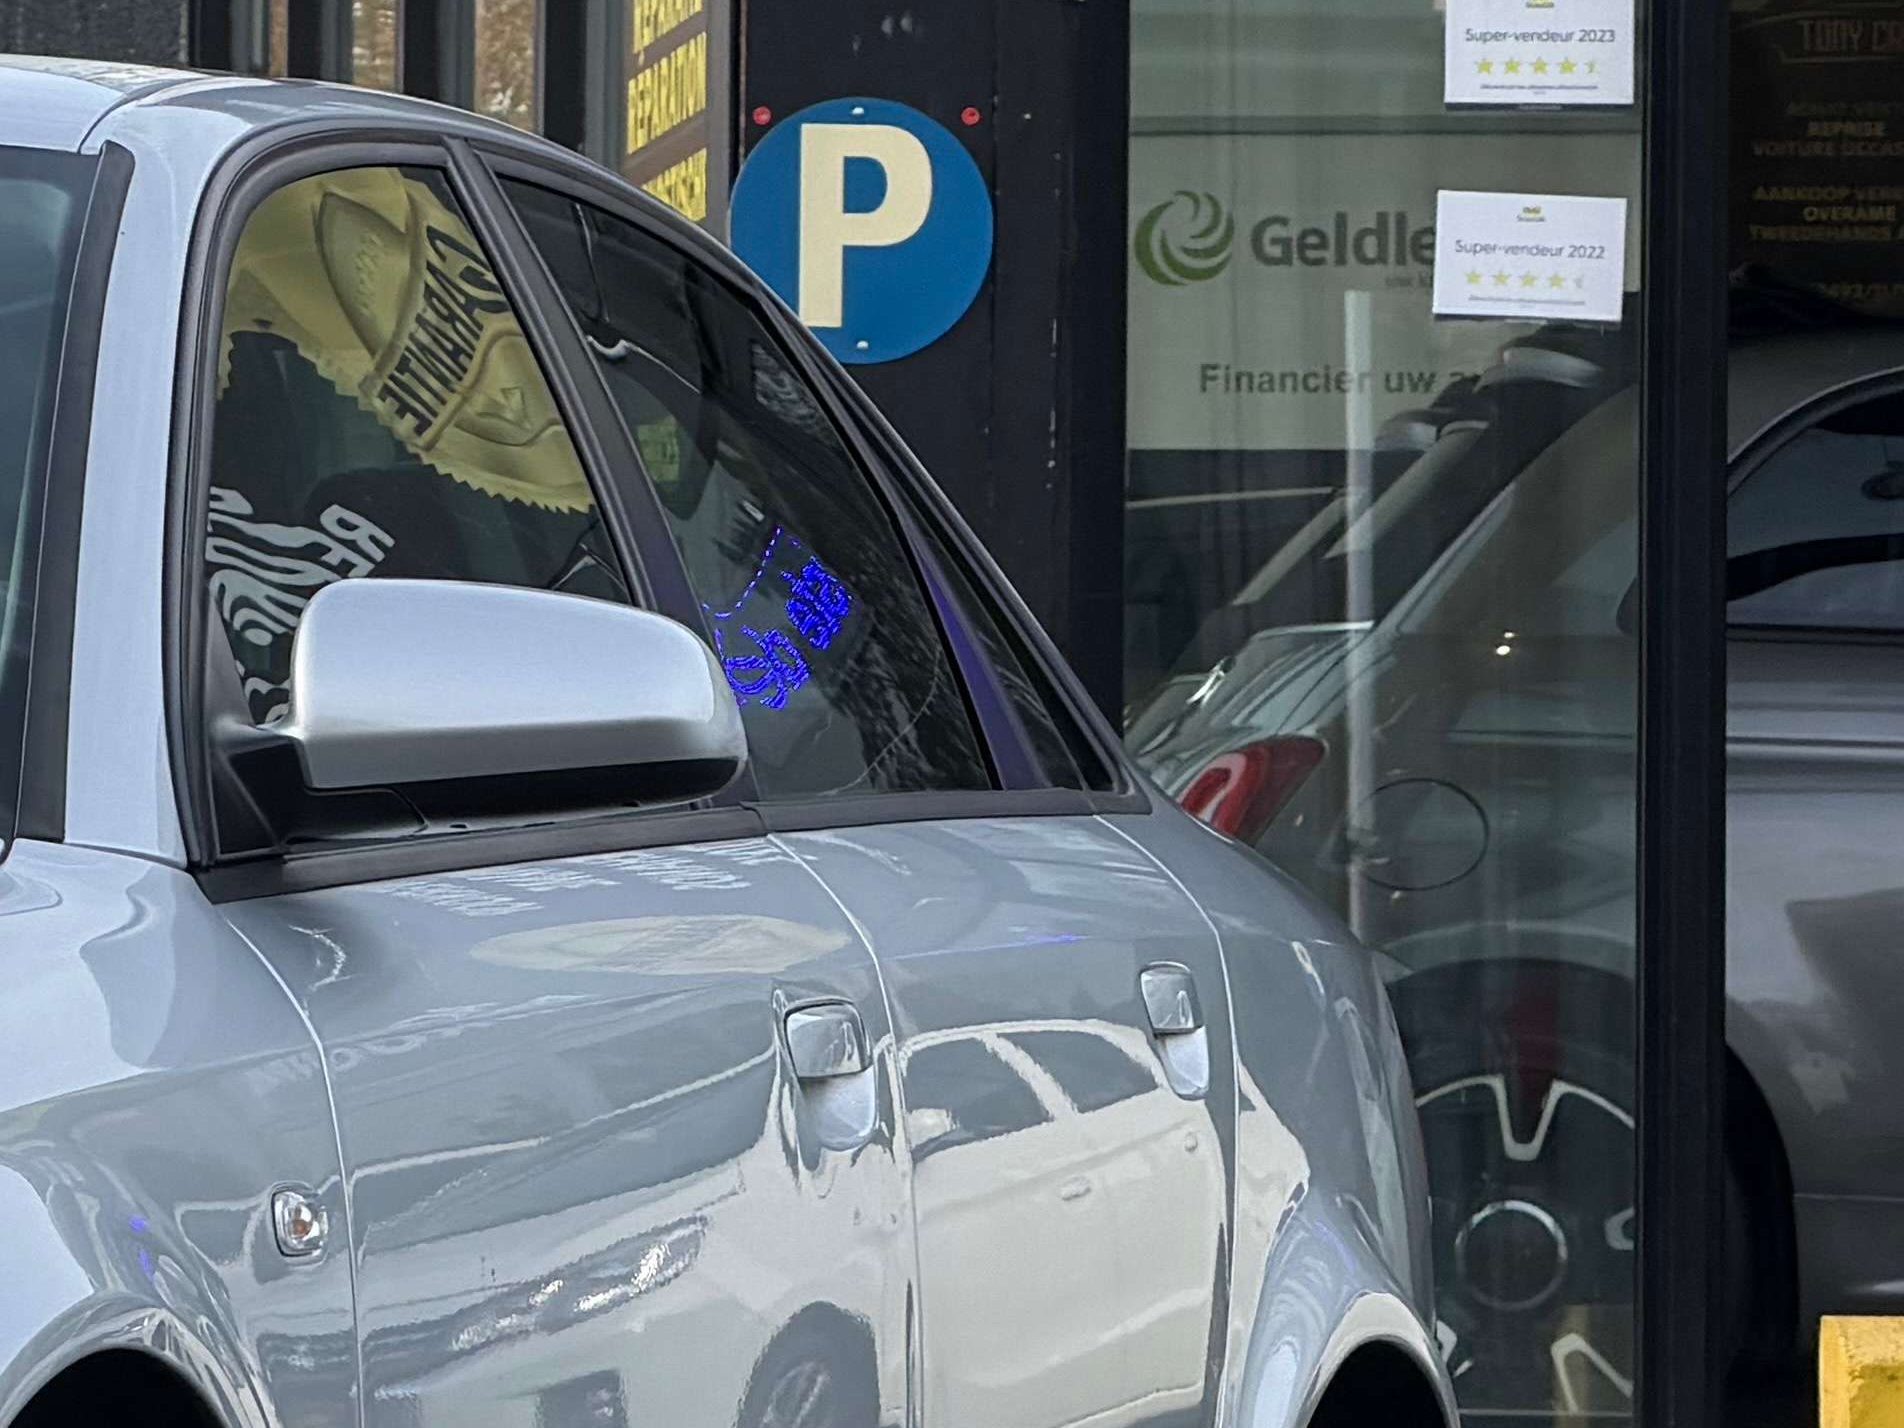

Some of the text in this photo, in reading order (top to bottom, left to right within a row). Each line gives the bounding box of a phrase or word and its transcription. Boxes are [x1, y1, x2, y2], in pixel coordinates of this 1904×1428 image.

[1465, 28, 1616, 45] Super-vendeur 2023
[798, 123, 933, 328] P
[1454, 239, 1606, 260] Super-vendeur 2022
[1199, 363, 1437, 394] Financier uw
